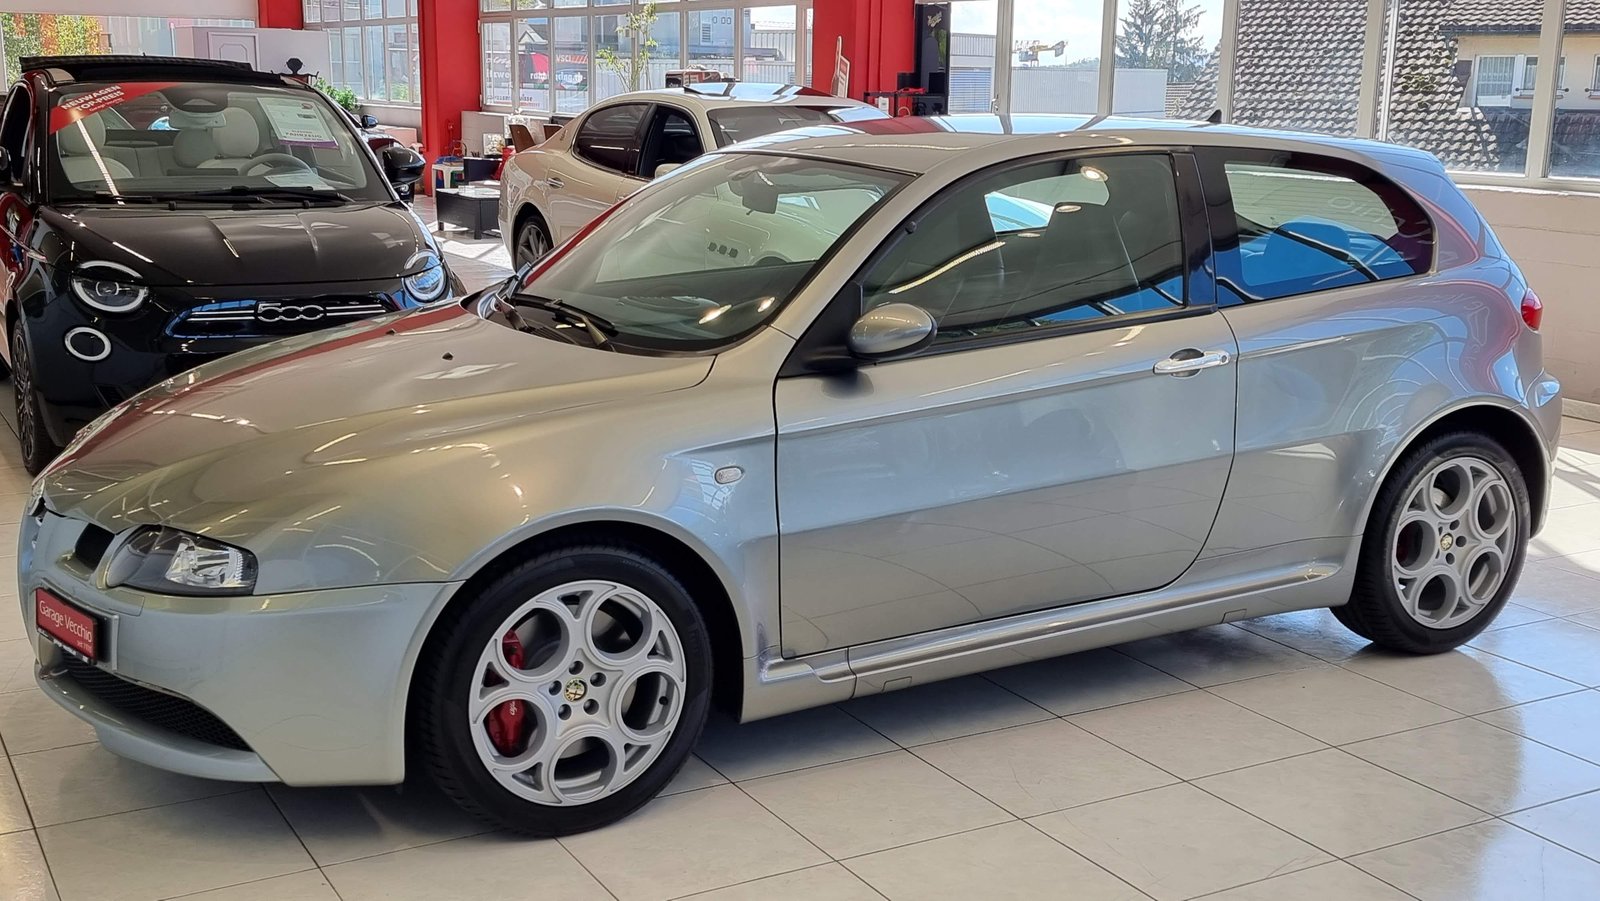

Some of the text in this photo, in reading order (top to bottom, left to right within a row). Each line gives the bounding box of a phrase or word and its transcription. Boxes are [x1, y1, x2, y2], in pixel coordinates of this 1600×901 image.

[61, 85, 121, 110] NEUWAGEN
[257, 301, 325, 322] 500
[40, 600, 93, 643] Garage Vecchio
